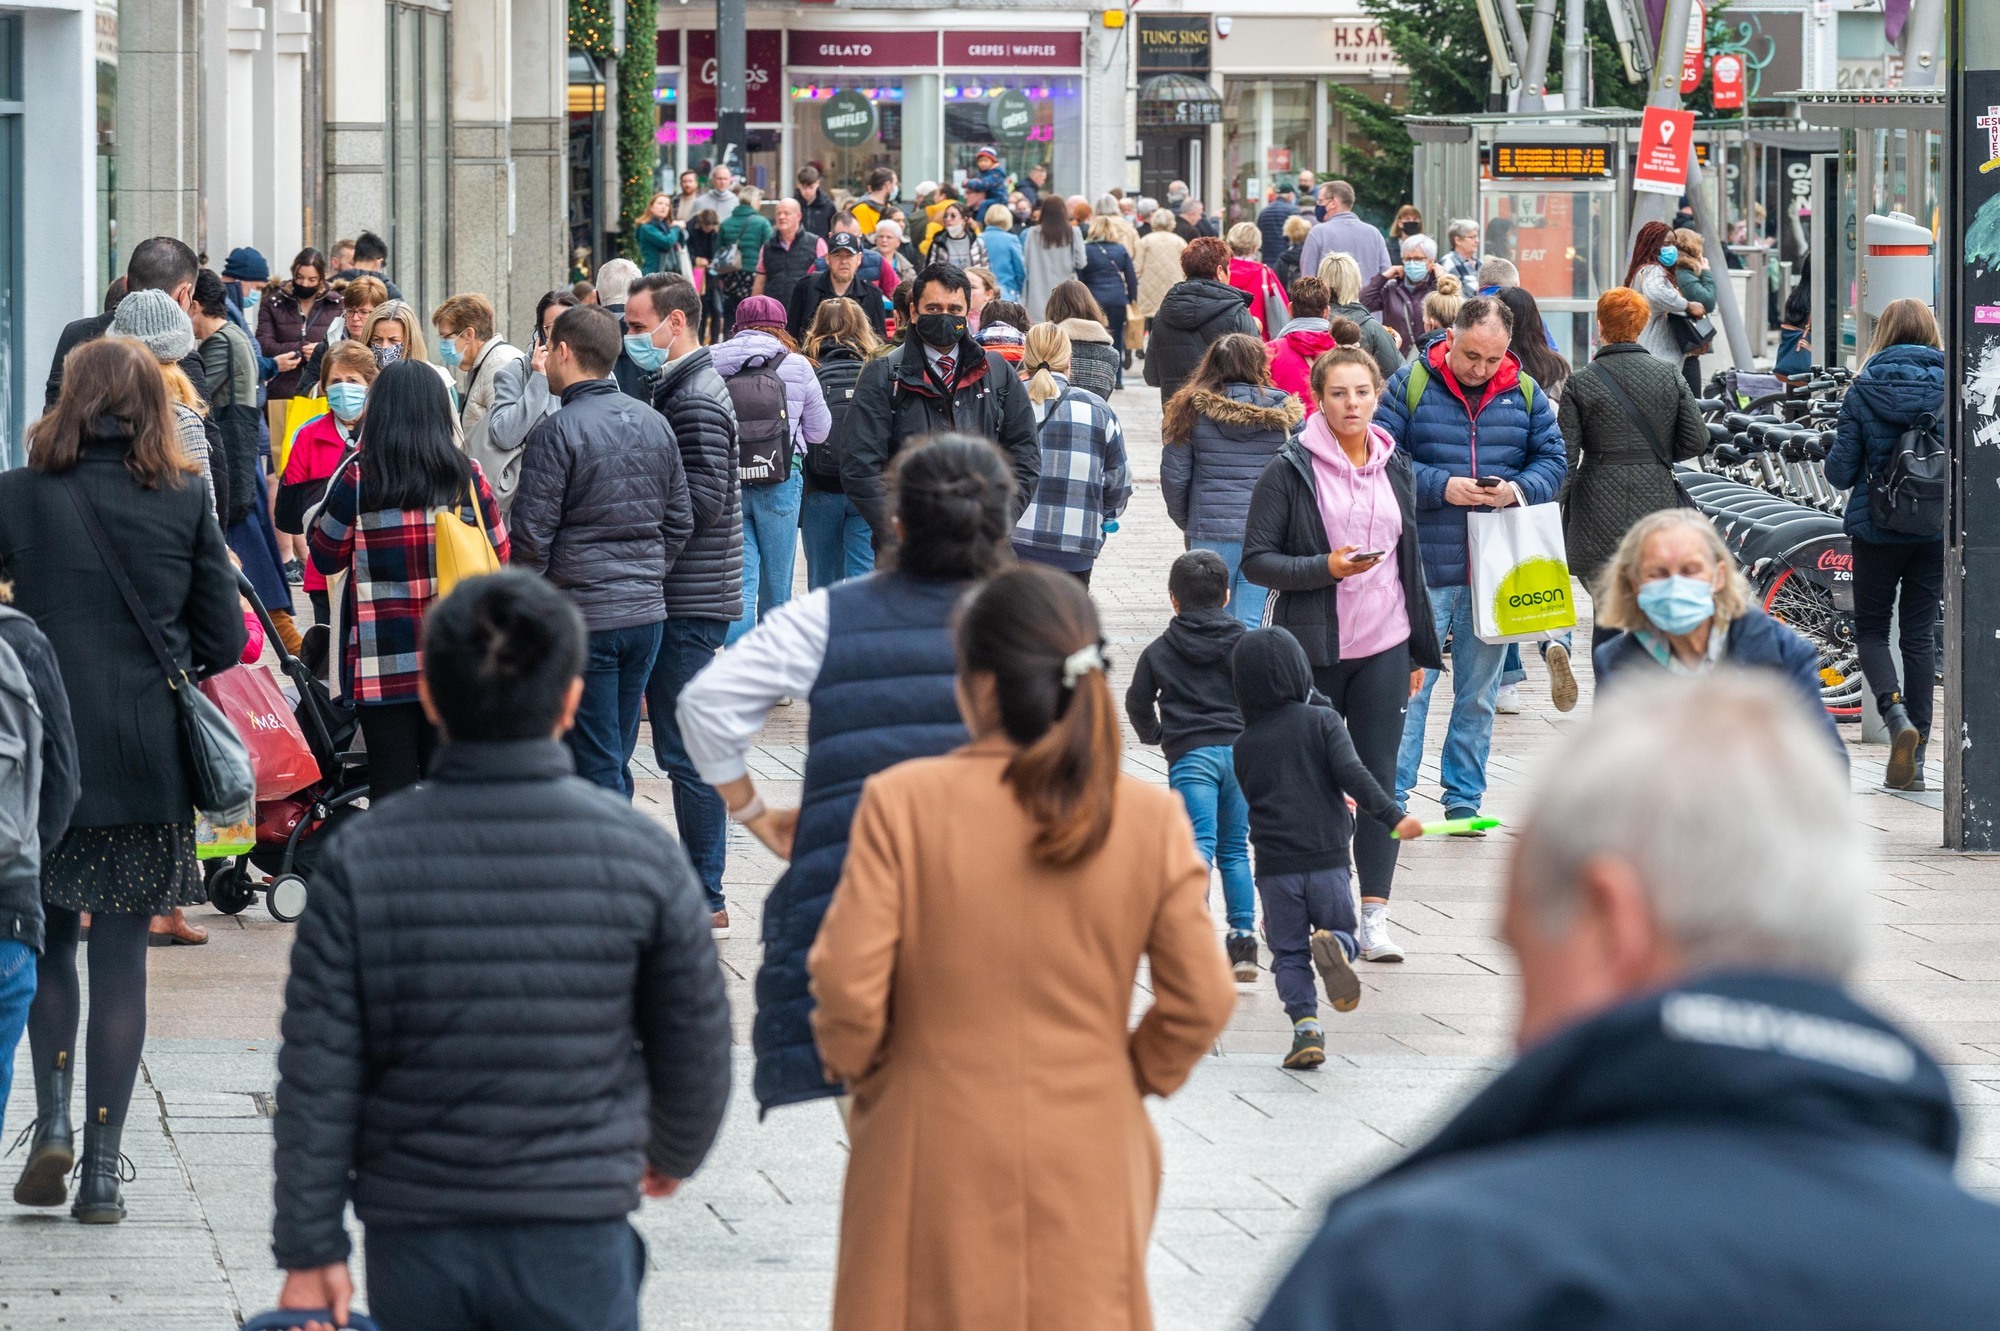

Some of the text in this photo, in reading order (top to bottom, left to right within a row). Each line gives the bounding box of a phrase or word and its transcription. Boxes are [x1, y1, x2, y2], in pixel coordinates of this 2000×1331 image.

[1141, 30, 1209, 45] TUNG SING
[819, 44, 873, 57] GELATO
[968, 44, 1057, 57] CREPES WAFFLES
[739, 465, 769, 480] UMA
[1509, 588, 1564, 608] eason
